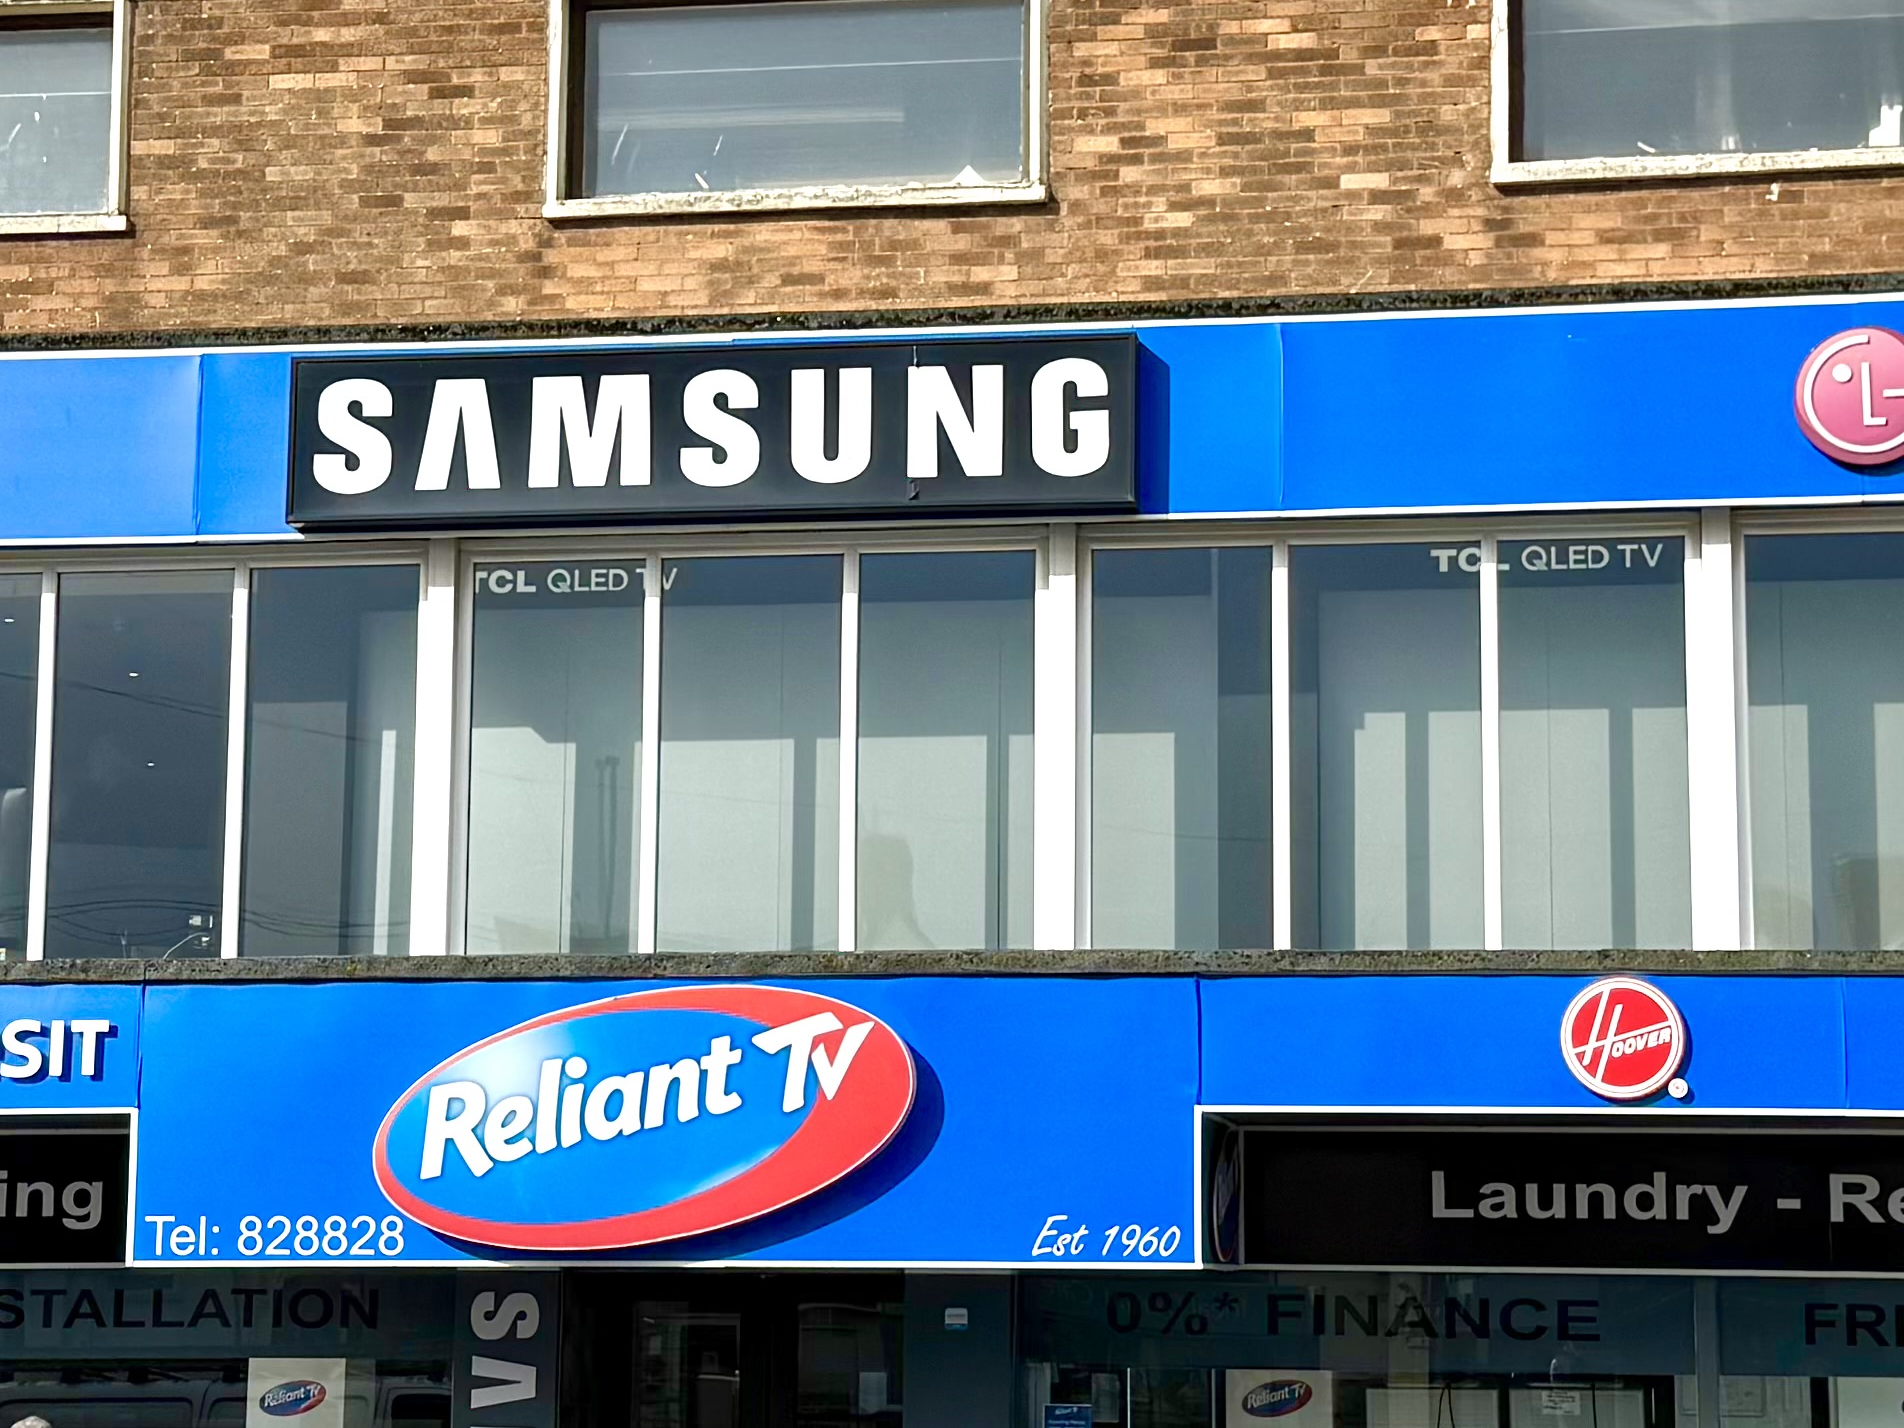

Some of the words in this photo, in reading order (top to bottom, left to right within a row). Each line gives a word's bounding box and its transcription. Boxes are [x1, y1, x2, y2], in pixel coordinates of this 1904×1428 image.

[311, 357, 1112, 496] SAMSUNG
[1521, 544, 1610, 571] QLED
[1617, 543, 1663, 568] TV
[546, 568, 629, 593] QLED
[418, 1034, 744, 1181] Reliant
[1430, 1170, 1748, 1234] Laundry
[144, 1215, 221, 1256] Tel:
[237, 1214, 405, 1257] 828828
[1031, 1214, 1085, 1257] Est
[1102, 1224, 1181, 1257] 1960
[1266, 1293, 1602, 1342] FINANCE
[264, 1387, 305, 1408] Reliant
[1247, 1385, 1289, 1409] Reliant
